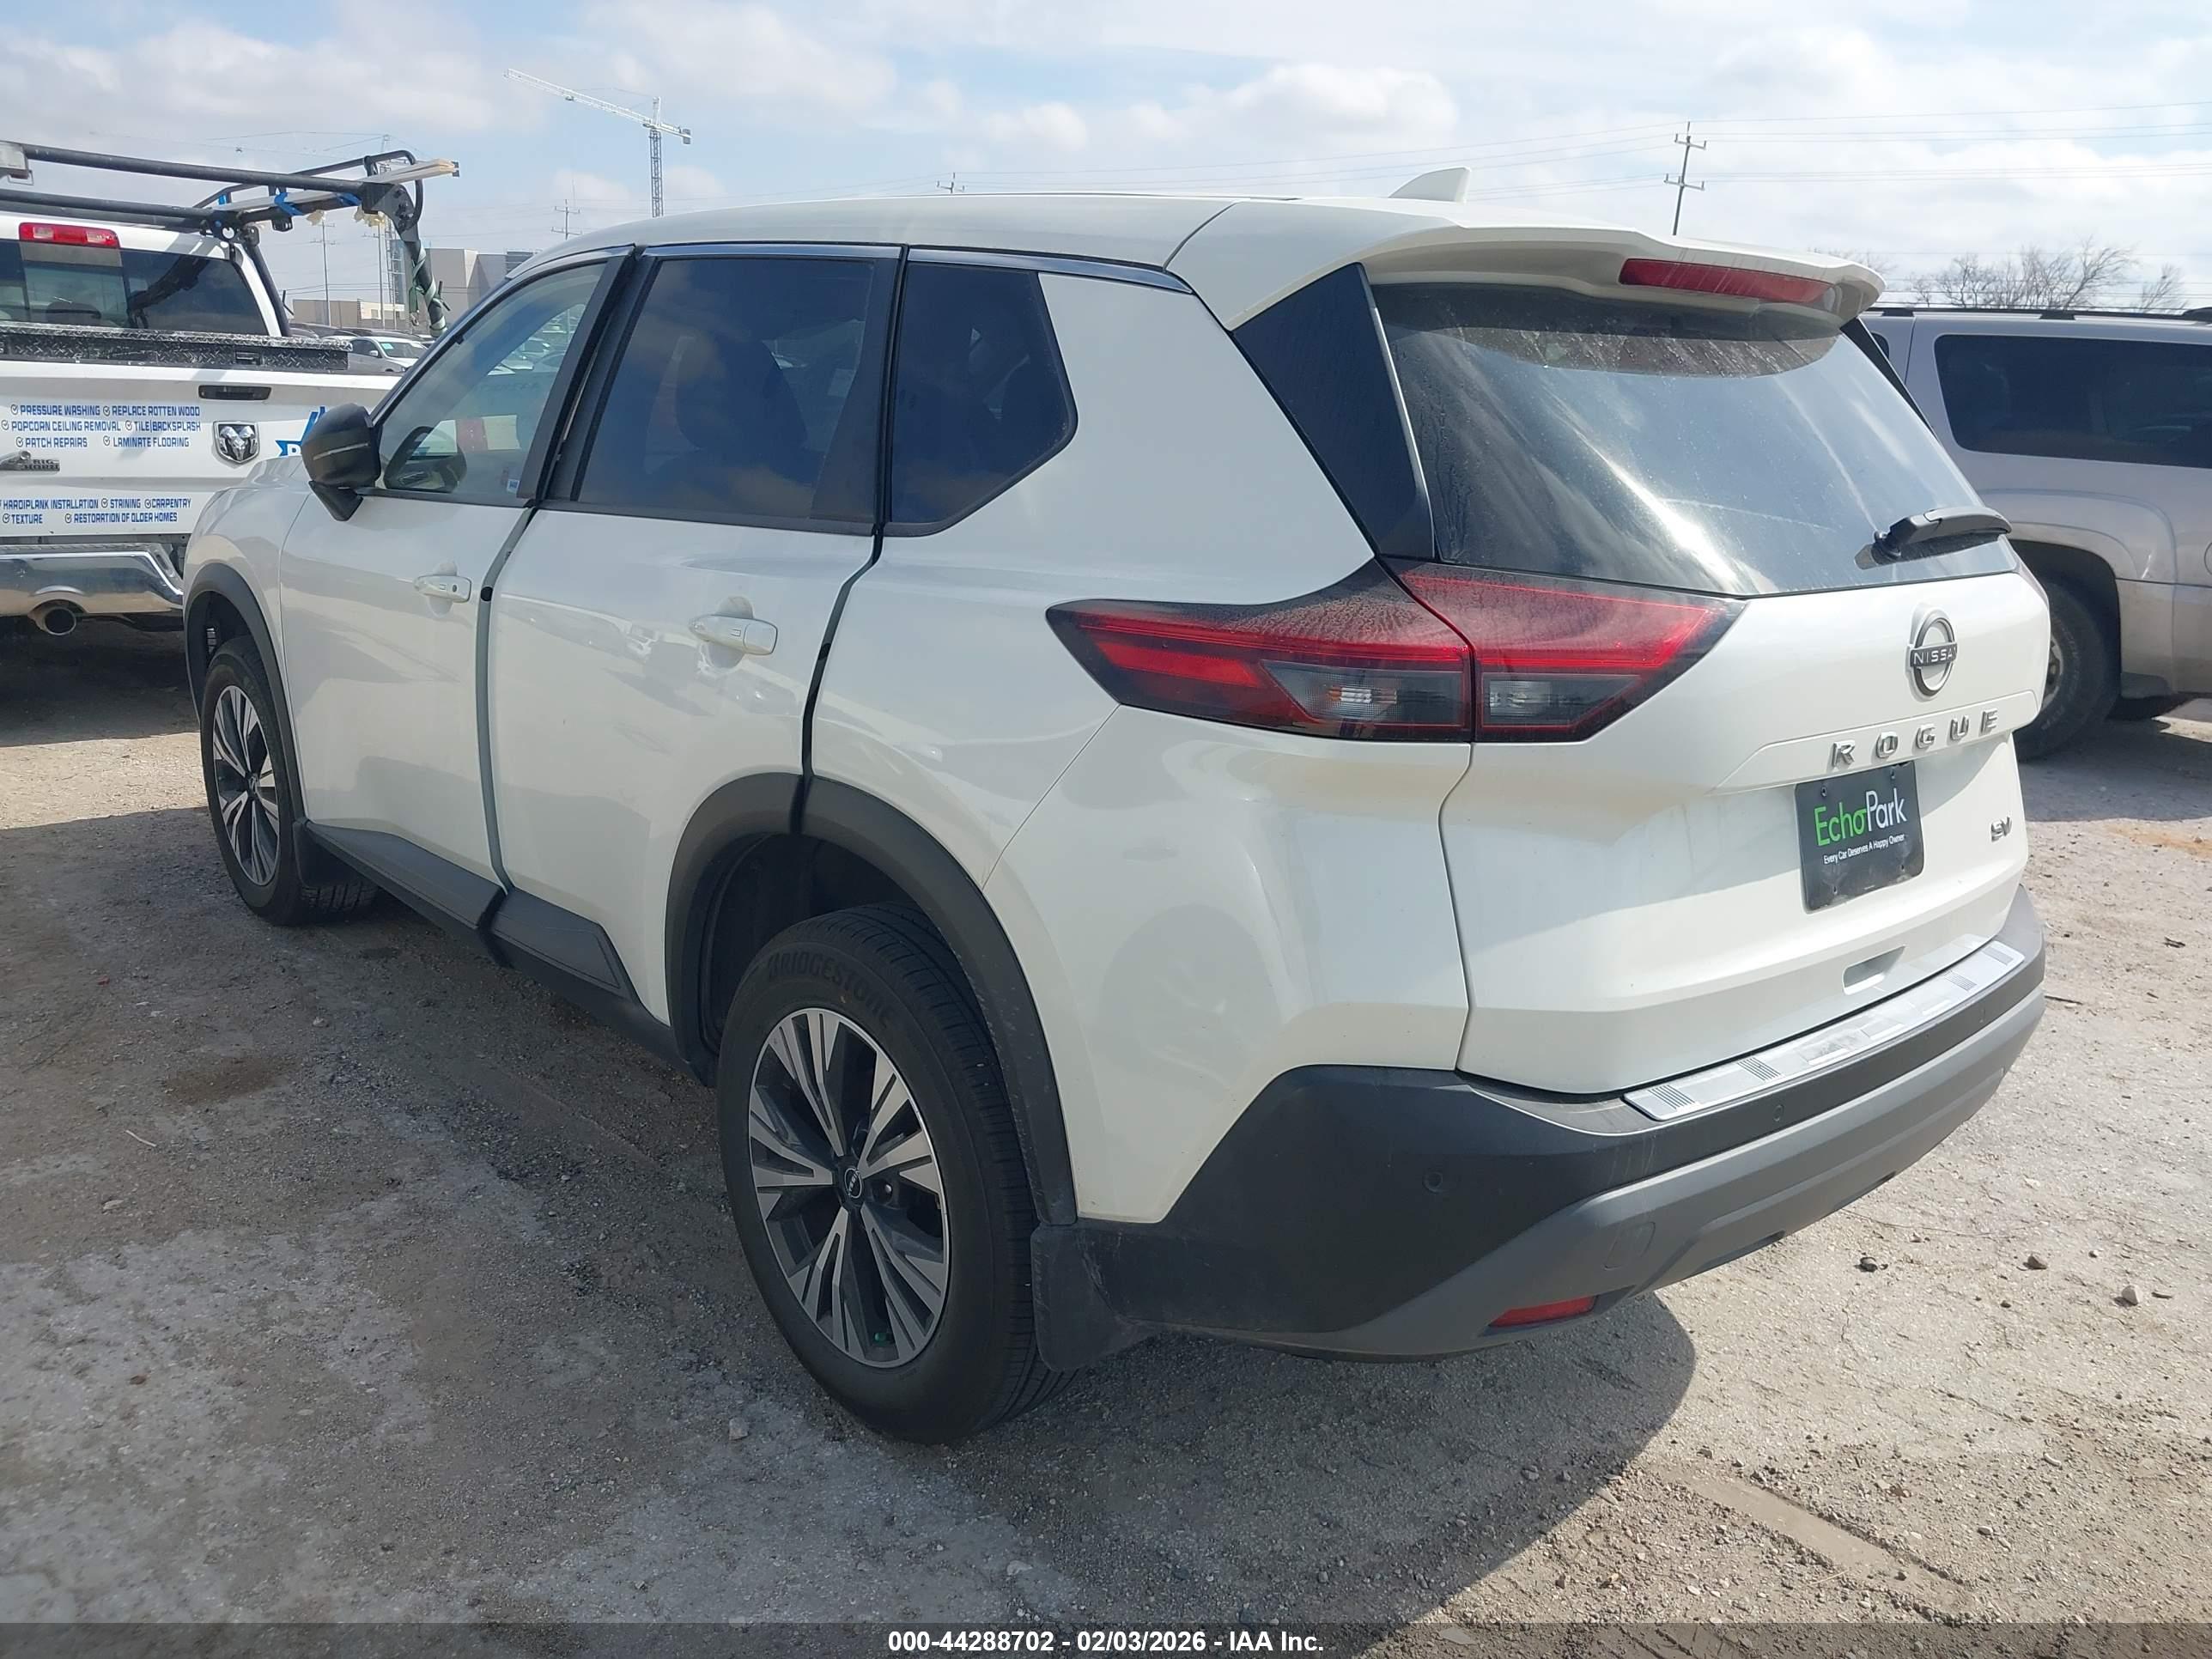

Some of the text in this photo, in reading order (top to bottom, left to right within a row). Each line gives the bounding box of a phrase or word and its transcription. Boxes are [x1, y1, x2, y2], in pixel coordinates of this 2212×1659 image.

[20, 404, 100, 416] PRESSURE WASHING
[112, 405, 201, 416] REPLACE ROTTEN WOOD
[11, 421, 121, 431] POPCORN CEILING REMOVAL
[25, 437, 88, 447] PATCH REPAIRS
[112, 436, 190, 447] LAMINATE FLOORING
[3, 499, 99, 509] HARDIPLANK INSTALLATION
[110, 498, 141, 508] STAINING
[151, 498, 191, 508] CARPENTRY
[11, 514, 43, 524] TEXTURE
[73, 512, 178, 523] RESTORATION OF OLDER HOMES
[1831, 707, 1999, 768] ROGUE
[1814, 787, 1907, 847] EchoPark
[1823, 854, 1838, 864] Every
[1838, 850, 1848, 860] Car
[1847, 844, 1869, 858] Deserves
[1873, 838, 1889, 850] Happy
[1888, 834, 1905, 845] Owner
